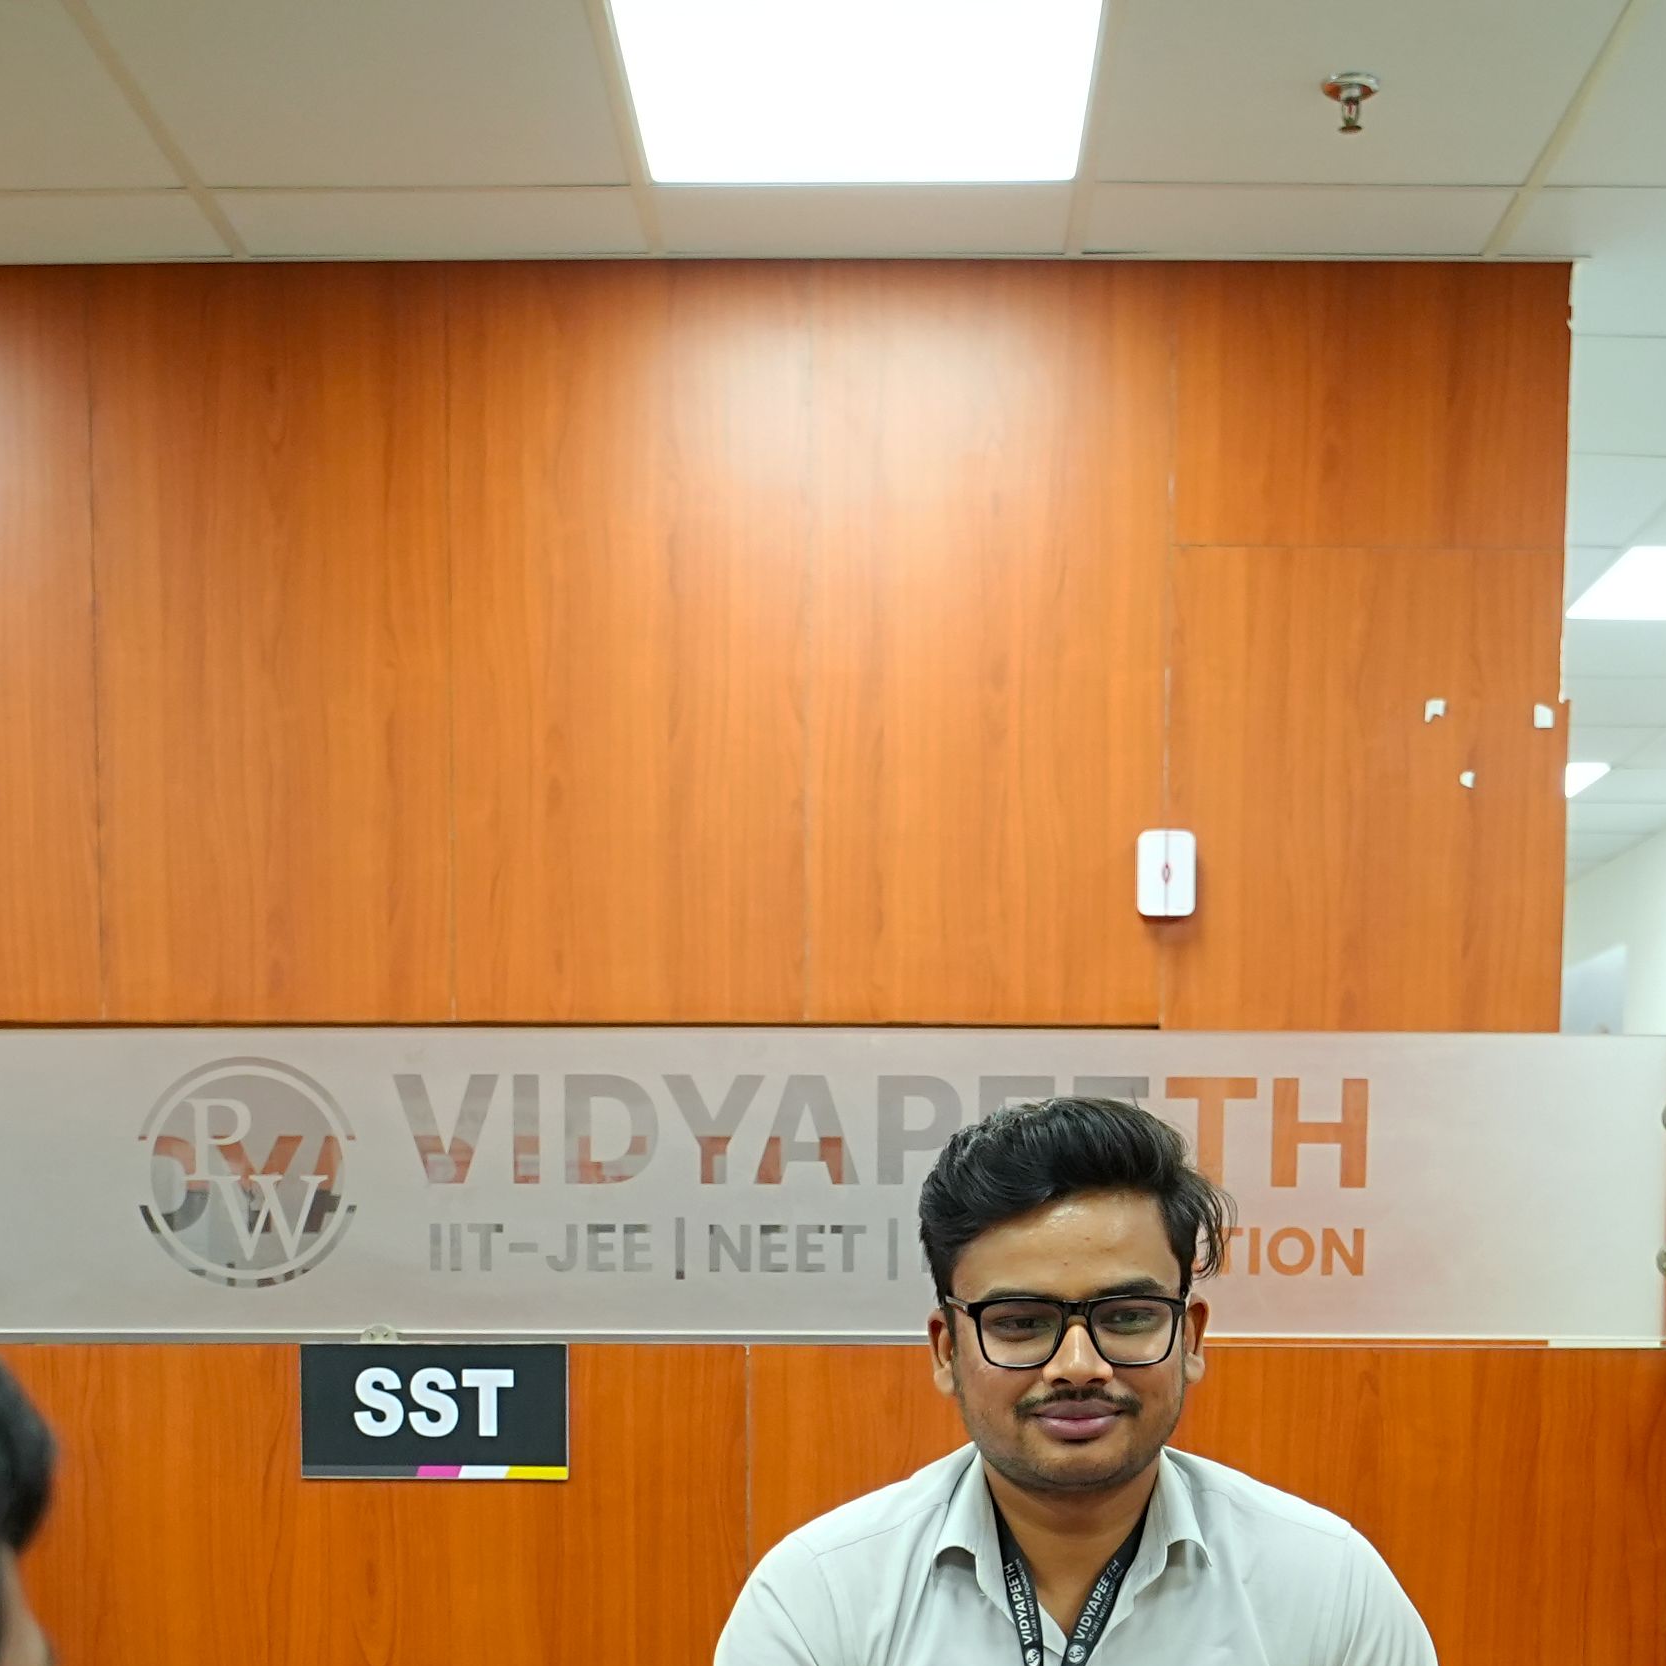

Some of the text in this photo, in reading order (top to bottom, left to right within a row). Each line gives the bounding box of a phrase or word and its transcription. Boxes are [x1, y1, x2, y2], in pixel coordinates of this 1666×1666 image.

[393, 1074, 1369, 1188] VIDYAPTH
[709, 1224, 866, 1273] NEET
[353, 1367, 515, 1438] SST
[1004, 1562, 1033, 1645] VIDYAPEETH
